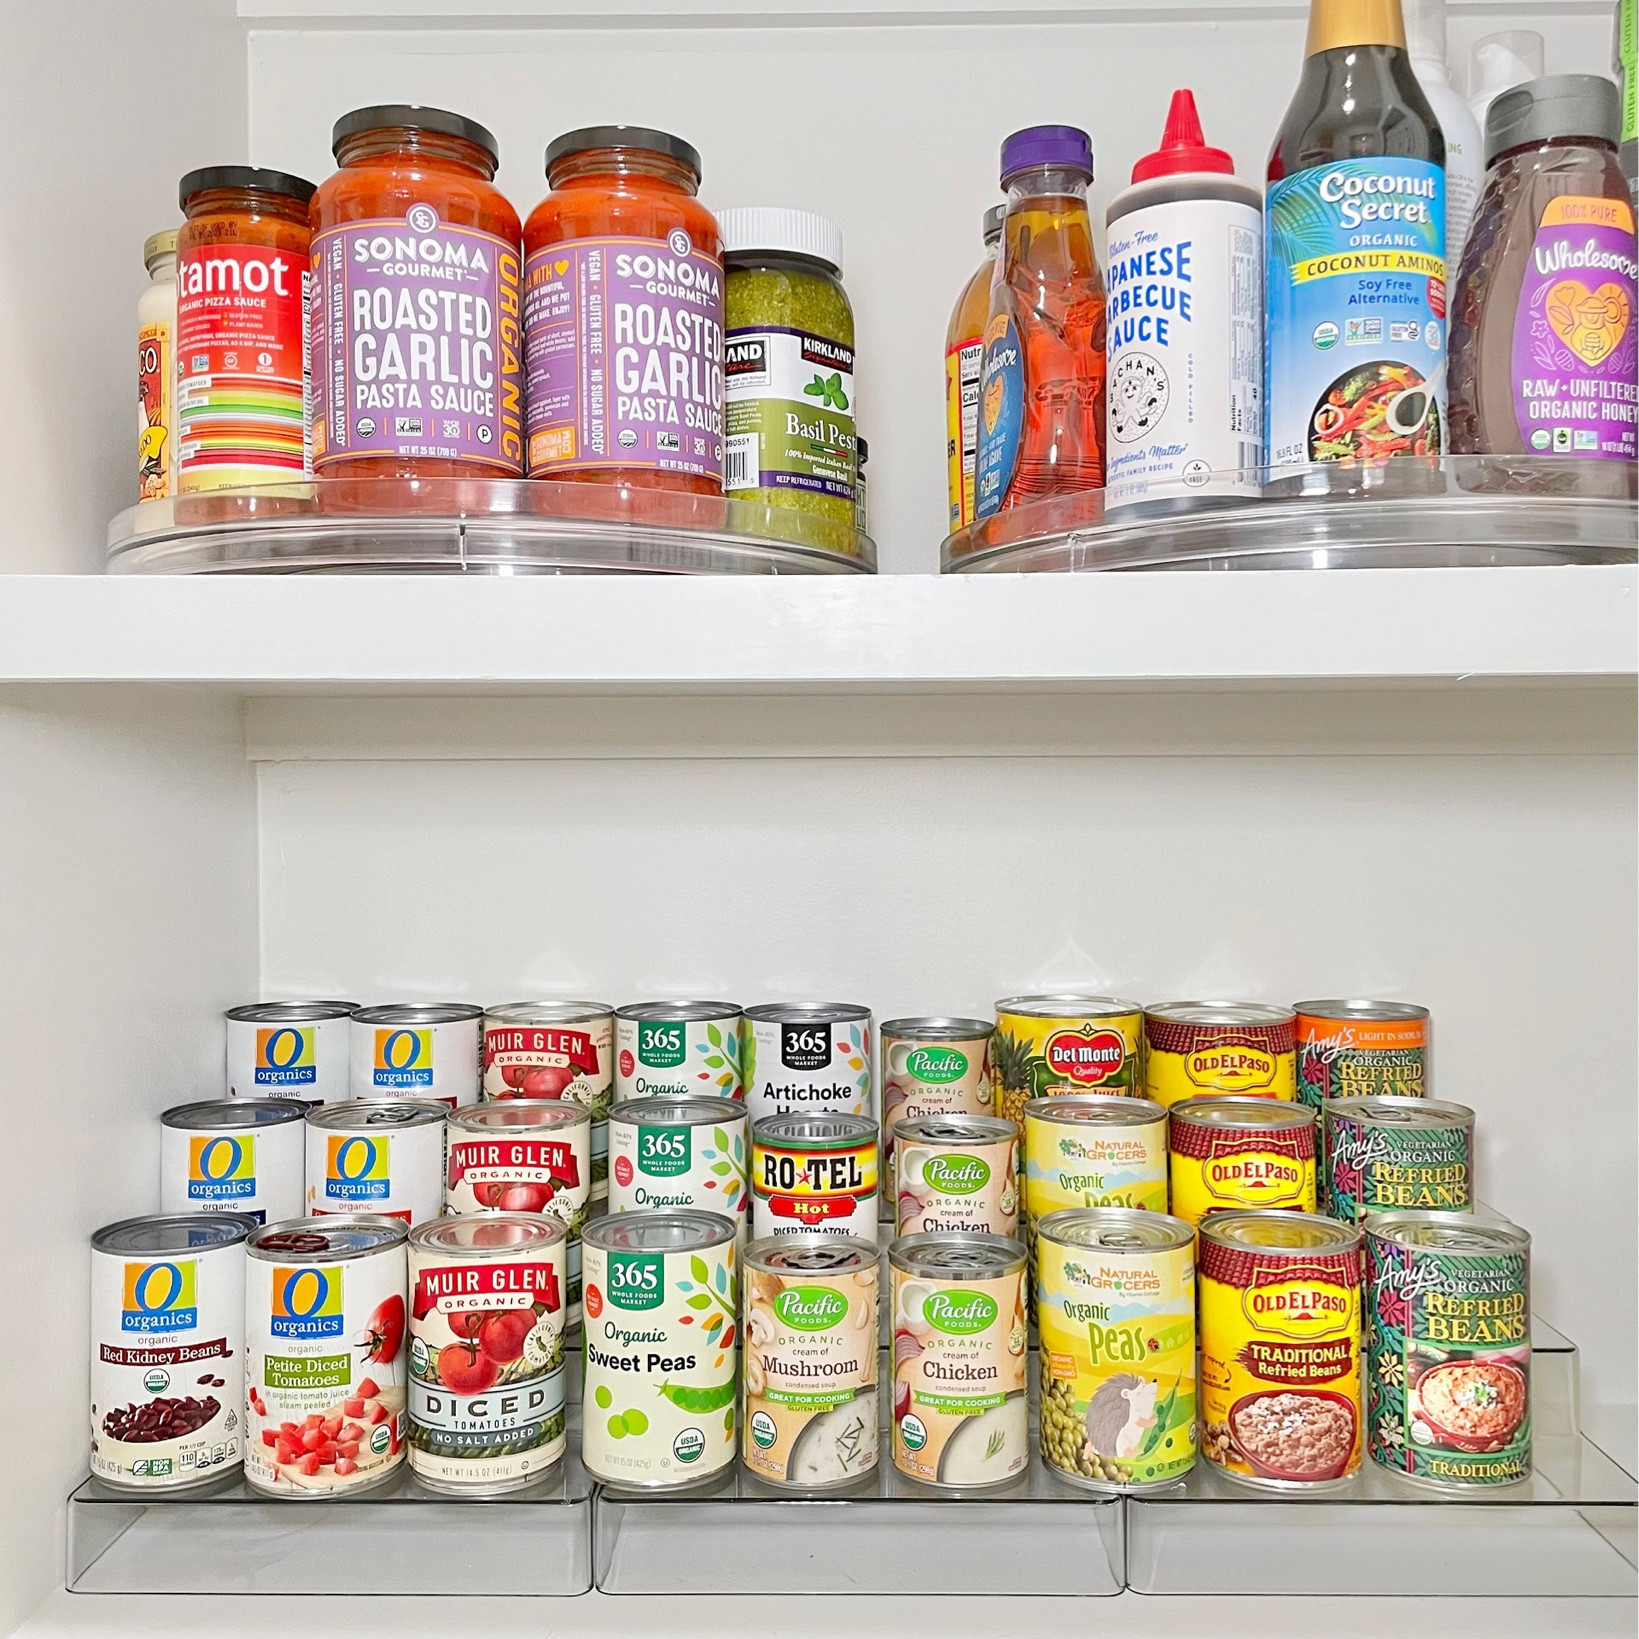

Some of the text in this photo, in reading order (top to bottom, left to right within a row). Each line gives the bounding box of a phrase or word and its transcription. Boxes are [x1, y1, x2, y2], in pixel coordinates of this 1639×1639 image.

[1319, 172, 1436, 204] Coconut
[1340, 198, 1428, 229] Secret
[1561, 204, 1618, 222] 100% PURE
[1349, 232, 1418, 248] ORGANIC
[354, 236, 489, 274] SONOMA
[1535, 239, 1638, 280] Wholesome
[383, 262, 464, 282] GOURMET
[532, 264, 552, 285] WITH
[1307, 254, 1444, 277] COCONUT AMINOS
[177, 257, 289, 298] tamot
[616, 254, 720, 300] SONOMA
[1358, 278, 1412, 292] Soy Free
[204, 296, 232, 307] PIZZA
[234, 296, 266, 308] SAUCE
[646, 282, 710, 307] GOURMET
[1348, 293, 1420, 306] Alternative
[353, 287, 492, 340] ROASTED
[614, 303, 721, 363] ROASTED
[1108, 315, 1169, 363] SAUCE
[499, 252, 521, 462] ORGANIC
[804, 338, 852, 364] KIRKLAND
[354, 332, 494, 390] GARLIC
[615, 347, 722, 411] GARLIC
[1522, 378, 1638, 403] RAW UNFILTERE
[356, 384, 423, 410] PASTA
[430, 384, 494, 418] SAUCE
[616, 396, 722, 438] PASTA SAUCE
[1529, 400, 1638, 424] ORGANIC HONEY
[785, 413, 856, 451] Basil Pest
[785, 448, 802, 459] 100%
[802, 452, 826, 464] Imported
[1149, 444, 1187, 458] Matter
[1126, 462, 1174, 477] FAMILY RECIPE
[776, 474, 790, 484] KEEP
[790, 476, 822, 489] REFRIGERATED
[826, 481, 836, 491] NET
[488, 1032, 524, 1052] MUIR
[642, 1026, 681, 1050] 365
[785, 1030, 826, 1054] 365
[1358, 1032, 1384, 1041] LIGHT
[1386, 1032, 1396, 1040] IN
[1052, 1046, 1120, 1062] Del Monte
[1303, 1028, 1356, 1067] Amy's
[499, 1055, 563, 1065] ORGANIC
[912, 1051, 963, 1072] Pacific
[1194, 1056, 1220, 1073] OLD
[1354, 1056, 1413, 1066] ORGANIC
[258, 1070, 313, 1084] organics
[376, 1072, 430, 1086] organics
[1073, 1066, 1103, 1076] Quality
[1340, 1061, 1422, 1082] REFRIED
[636, 1078, 690, 1097] Organic
[763, 1082, 852, 1101] Artichoke
[910, 1087, 964, 1098] ORGANIC
[1342, 1080, 1423, 1098] BEANS
[642, 1132, 686, 1158] 365
[1084, 1149, 1146, 1160] GROCERS
[1094, 1140, 1144, 1150] NATURAL
[1331, 1128, 1389, 1181] Amy's
[455, 1146, 500, 1168] MUIR
[1390, 1150, 1456, 1163] ORGANIC
[470, 1170, 544, 1180] ORGANIC
[764, 1154, 863, 1190] RO TEL
[928, 1158, 986, 1181] Pacific
[1212, 1162, 1241, 1182] OLD
[1242, 1162, 1264, 1178] EL
[1373, 1161, 1466, 1184] REFRIED
[190, 1182, 252, 1198] organics
[328, 1182, 386, 1198] organics
[1059, 1172, 1104, 1193] Organic
[634, 1187, 694, 1209] Organic
[926, 1198, 986, 1209] ORGANIC
[1374, 1182, 1466, 1207] BEANS
[793, 1202, 830, 1215] Hot
[612, 1262, 658, 1290] 365
[1099, 1266, 1158, 1280] NATURAL
[1375, 1254, 1442, 1302] Amy's
[1450, 1268, 1511, 1278] VEGETARIAN
[426, 1271, 480, 1296] MUIR
[1090, 1278, 1160, 1291] GROCERS
[1444, 1278, 1514, 1293] ORGANIC
[444, 1298, 526, 1309] ORGANIC
[780, 1291, 843, 1316] Pacific
[929, 1294, 993, 1319] Pacific
[1063, 1300, 1110, 1323] Organic
[1252, 1294, 1286, 1313] OLD
[1288, 1292, 1309, 1310] EL
[1425, 1291, 1526, 1316] REFRIED
[125, 1312, 192, 1330] organics
[274, 1318, 339, 1336] organics
[1426, 1314, 1526, 1343] BEANS
[138, 1334, 178, 1347] organic
[604, 1320, 668, 1348] Organic
[778, 1335, 844, 1346] ORGANIC
[103, 1342, 221, 1365] Red Kidney Beans
[288, 1344, 323, 1355] organic
[792, 1348, 828, 1356] cream of
[927, 1338, 993, 1350] ORGANIC
[1250, 1344, 1348, 1362] TRADITIONAL
[266, 1357, 348, 1372] Petite Diced
[588, 1343, 697, 1373] Sweet Peas
[942, 1351, 979, 1360] cream of
[762, 1354, 858, 1378] Mushroom
[922, 1360, 999, 1381] Chicken
[1258, 1362, 1342, 1378] Refried Beans
[272, 1372, 340, 1387] Tomatoes
[820, 1382, 837, 1390] soup
[272, 1390, 298, 1402] organic
[300, 1390, 328, 1400] tomato
[329, 1388, 350, 1400] juice
[768, 1392, 850, 1404] GREAT FOR COOKING
[971, 1386, 987, 1394] soup
[280, 1400, 331, 1410] steam peeled
[426, 1388, 546, 1418] DICED
[918, 1396, 945, 1406] GREAT
[964, 1396, 1001, 1406] COOKING
[454, 1417, 516, 1430] TOMATOES
[436, 1428, 534, 1445] NO SALT ADDED
[182, 1454, 194, 1462] 110
[1430, 1460, 1522, 1478] TRADITIONAL
